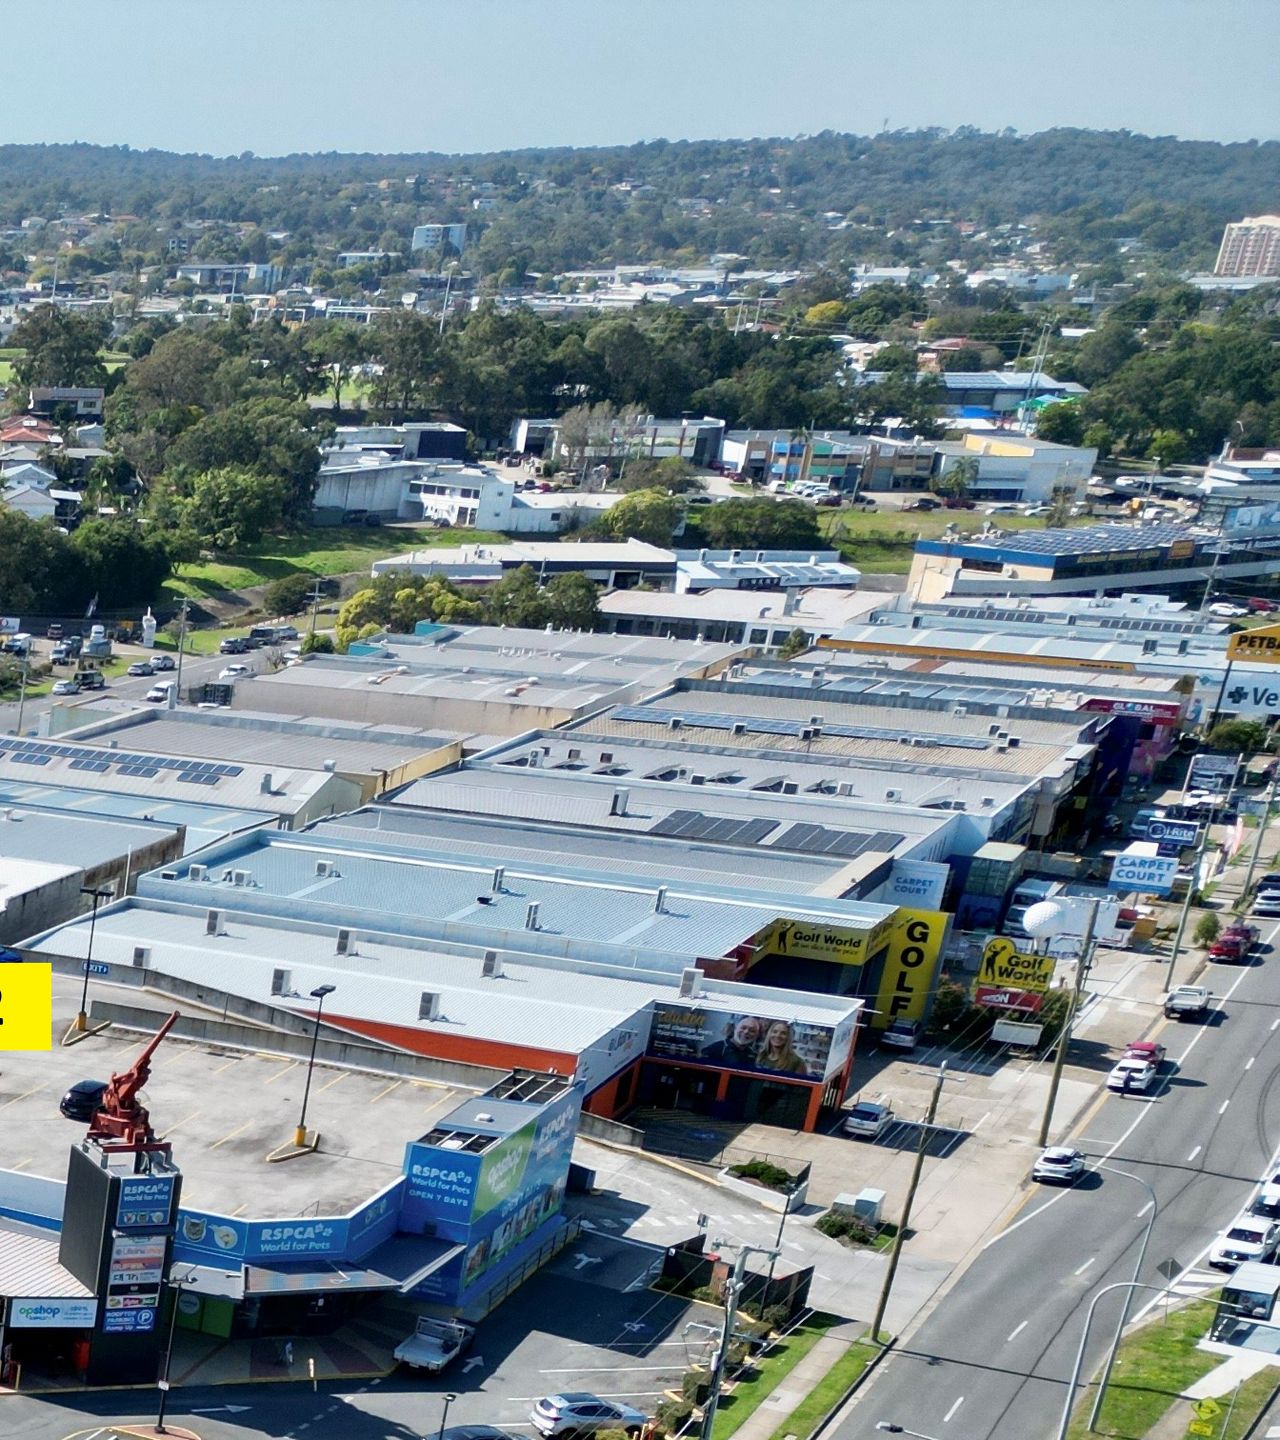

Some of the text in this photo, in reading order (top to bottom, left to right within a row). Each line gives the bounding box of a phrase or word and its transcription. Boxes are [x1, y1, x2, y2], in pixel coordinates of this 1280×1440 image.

[1237, 635, 1280, 650] PETB
[1119, 857, 1174, 872] CARPET
[895, 876, 934, 887] CARPET
[1116, 868, 1166, 882] COURT
[893, 884, 929, 896] COURT
[793, 930, 862, 949] Golf World
[889, 920, 930, 1018] GOLF
[1007, 955, 1045, 971] Golf
[998, 965, 1049, 984] World
[413, 1163, 459, 1182] RSPCA
[124, 1184, 158, 1194] RSPCA
[411, 1176, 471, 1195] World for Pets
[124, 1194, 143, 1202] World
[408, 1188, 434, 1201] OPEN
[445, 1193, 469, 1207] DAYS
[260, 1225, 315, 1241] RSPCA
[260, 1239, 331, 1253] World for Pets
[18, 1305, 61, 1319] opshop
